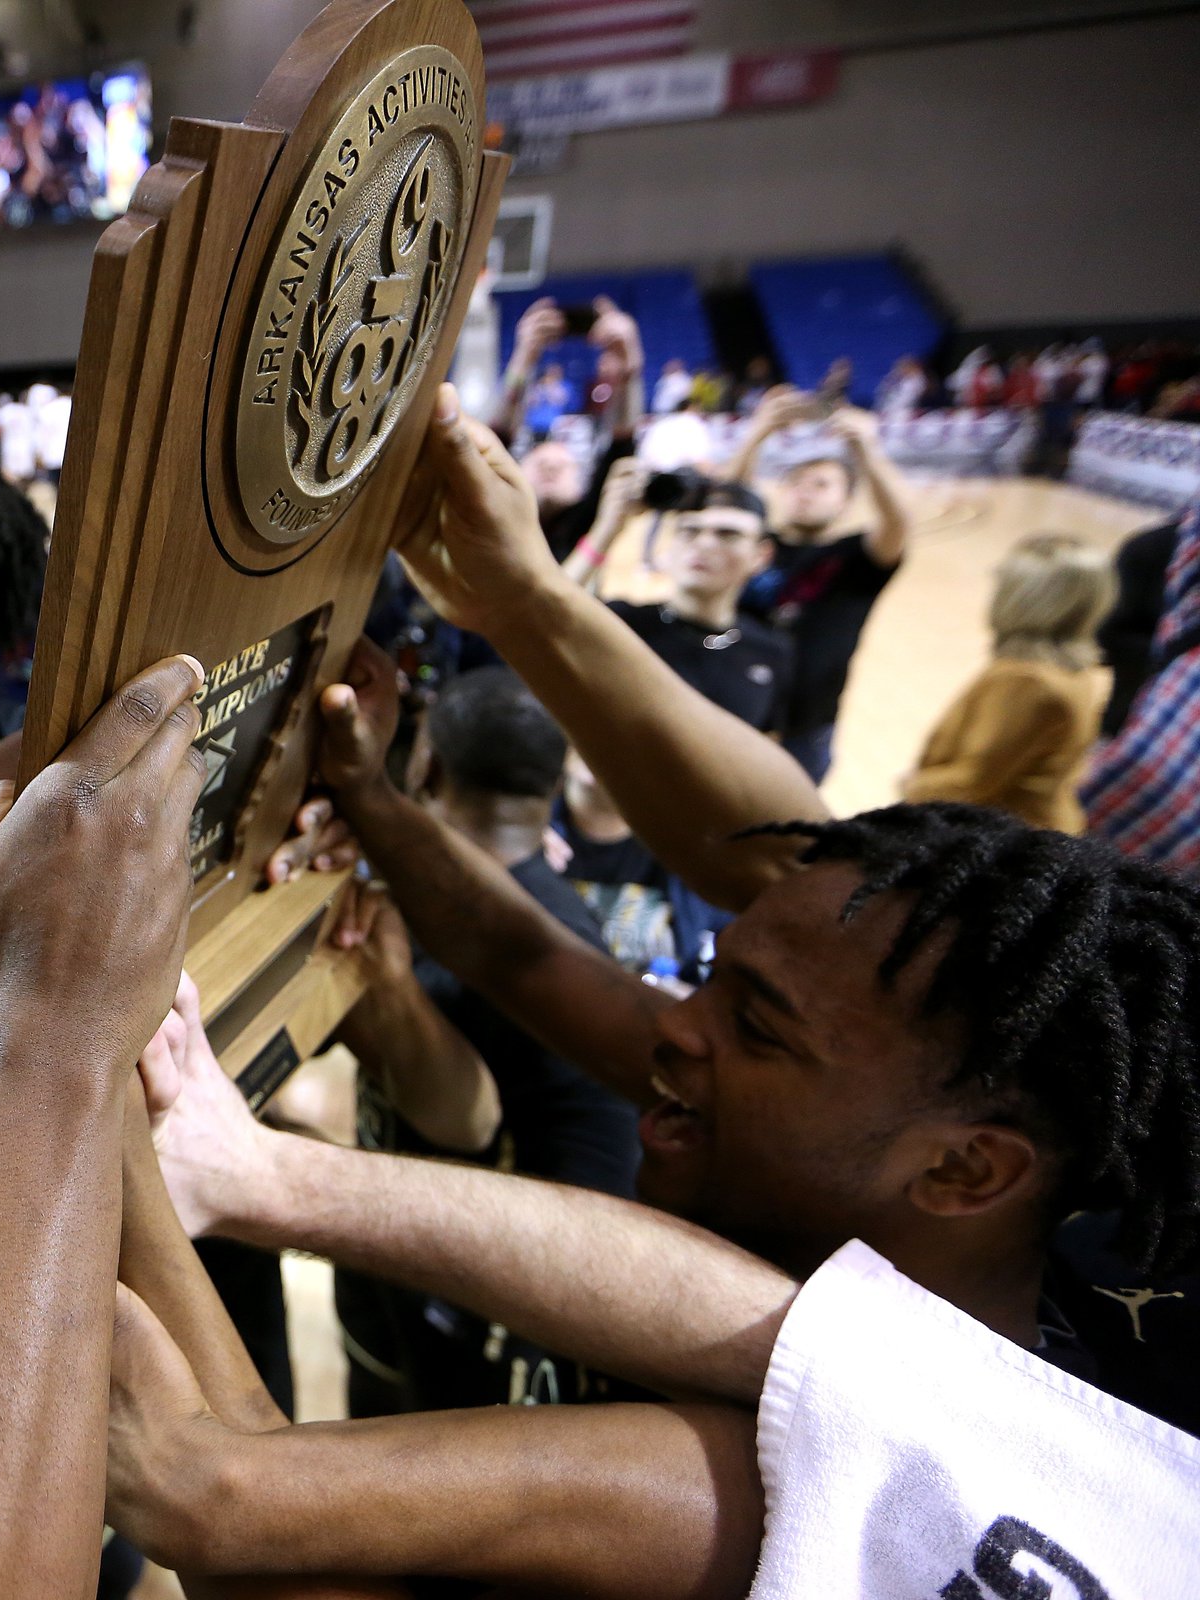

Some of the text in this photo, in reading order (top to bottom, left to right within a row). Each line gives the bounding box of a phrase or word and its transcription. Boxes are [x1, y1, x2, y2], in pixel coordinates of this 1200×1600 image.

[253, 66, 467, 405] ARKANSAS ACTIVITIES
[192, 639, 270, 705] STATE
[194, 656, 293, 740] MPIONS
